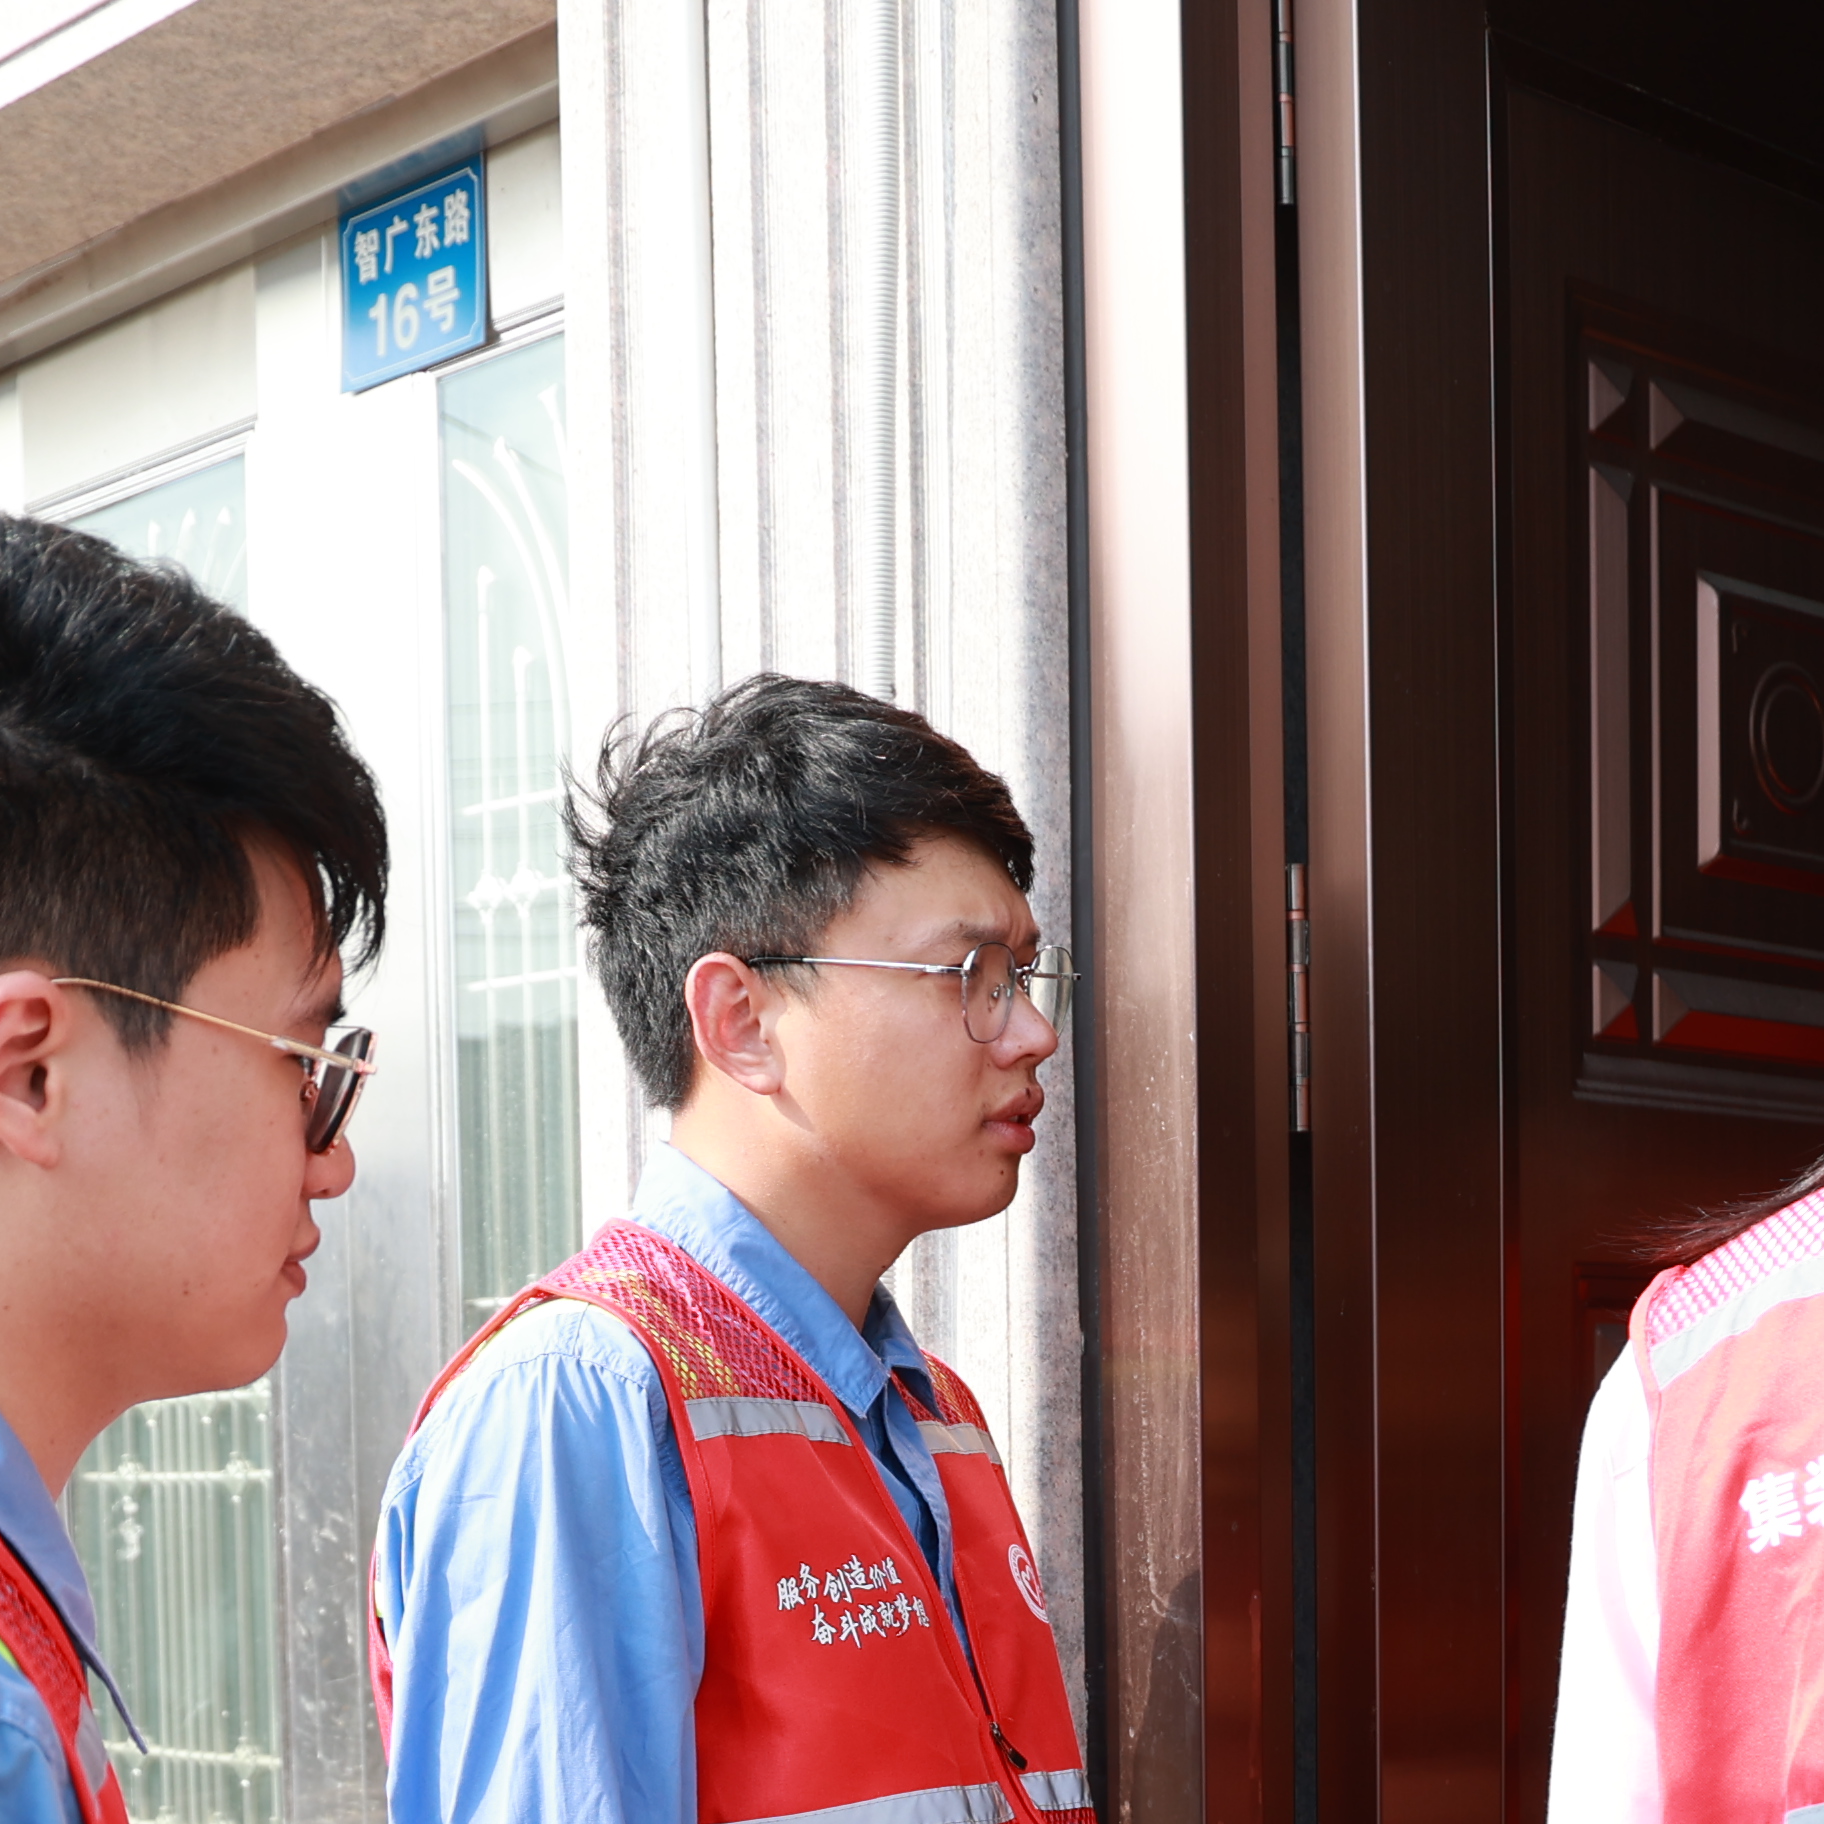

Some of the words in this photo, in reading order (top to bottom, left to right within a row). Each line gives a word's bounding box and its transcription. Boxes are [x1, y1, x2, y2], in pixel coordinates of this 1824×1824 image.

[353, 188, 471, 286] 智广东路
[367, 264, 461, 357] 16号
[776, 1554, 902, 1611] 服务创造价值
[811, 1592, 931, 1649] 奋斗成就梦想
